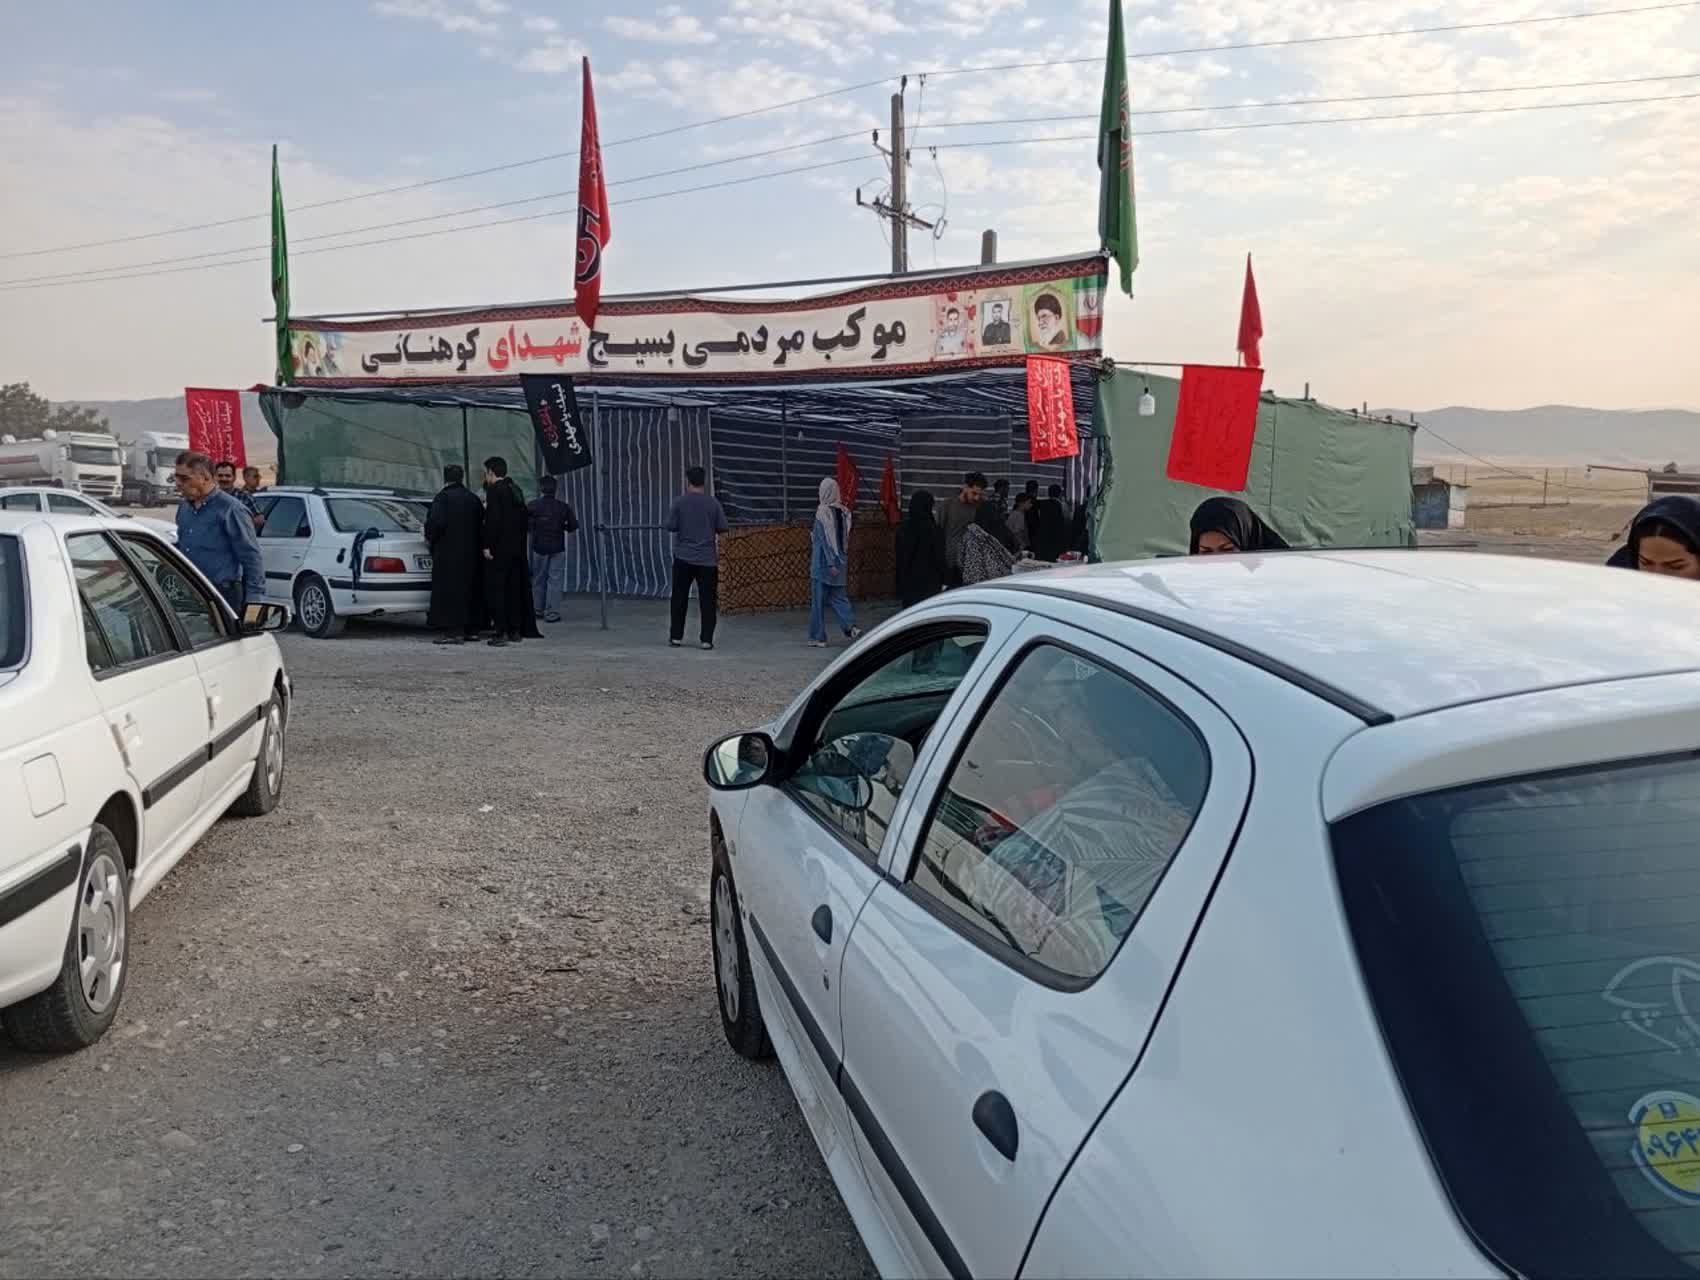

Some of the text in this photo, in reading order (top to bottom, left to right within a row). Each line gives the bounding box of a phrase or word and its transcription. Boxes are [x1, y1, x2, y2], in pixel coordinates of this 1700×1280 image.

[361, 306, 906, 373] موکب مردمی بسیج شهدای کوهنانی
